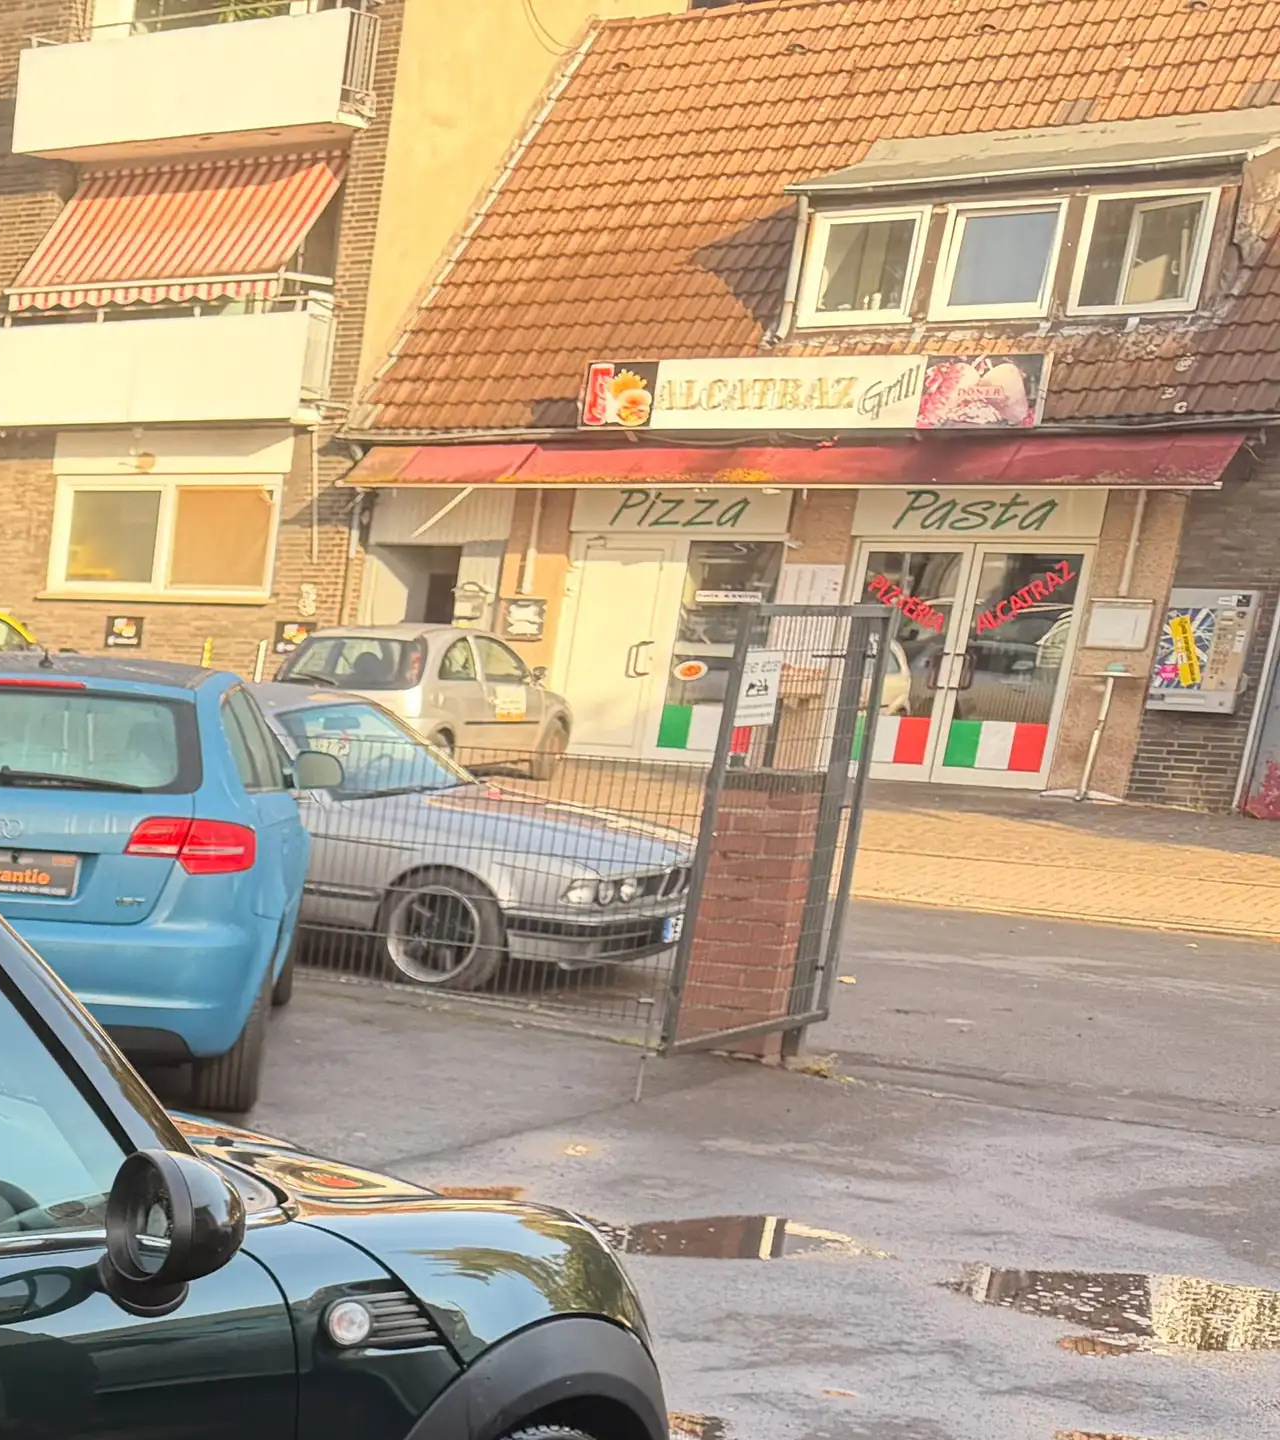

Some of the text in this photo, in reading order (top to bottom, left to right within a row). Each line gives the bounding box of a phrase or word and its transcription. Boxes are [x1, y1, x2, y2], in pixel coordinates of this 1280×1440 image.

[655, 376, 858, 412] ALCATRAZ
[857, 364, 922, 421] Grill
[609, 488, 751, 528] Pizza
[892, 489, 1058, 531] Pasta
[975, 559, 1075, 636] ALCATRAZ
